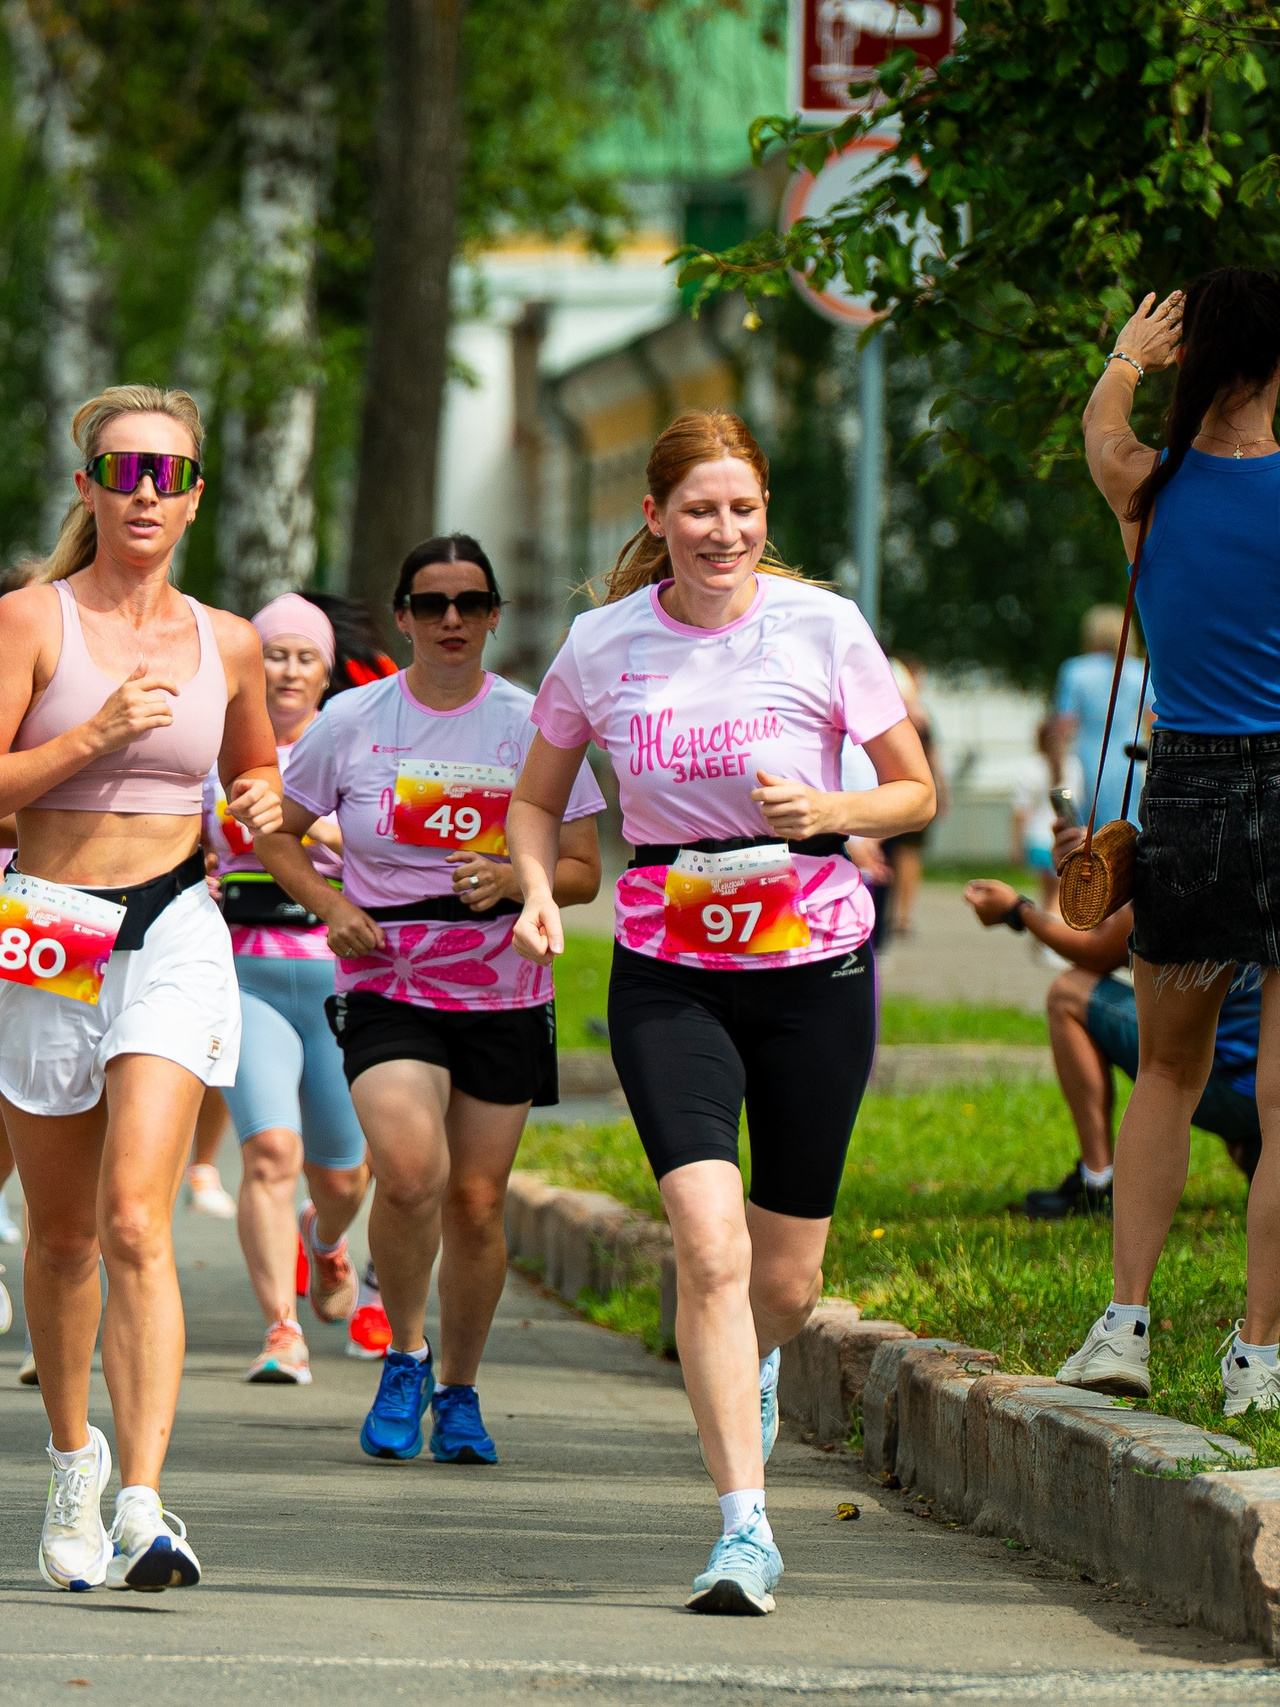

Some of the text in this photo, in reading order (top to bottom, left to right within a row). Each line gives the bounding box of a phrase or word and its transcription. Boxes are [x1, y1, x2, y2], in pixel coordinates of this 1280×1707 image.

[629, 707, 785, 776] Женский
[671, 752, 752, 783] ЗАБЕГ
[424, 805, 481, 841] 49
[701, 901, 762, 943] 97
[832, 965, 865, 978] DEMIX
